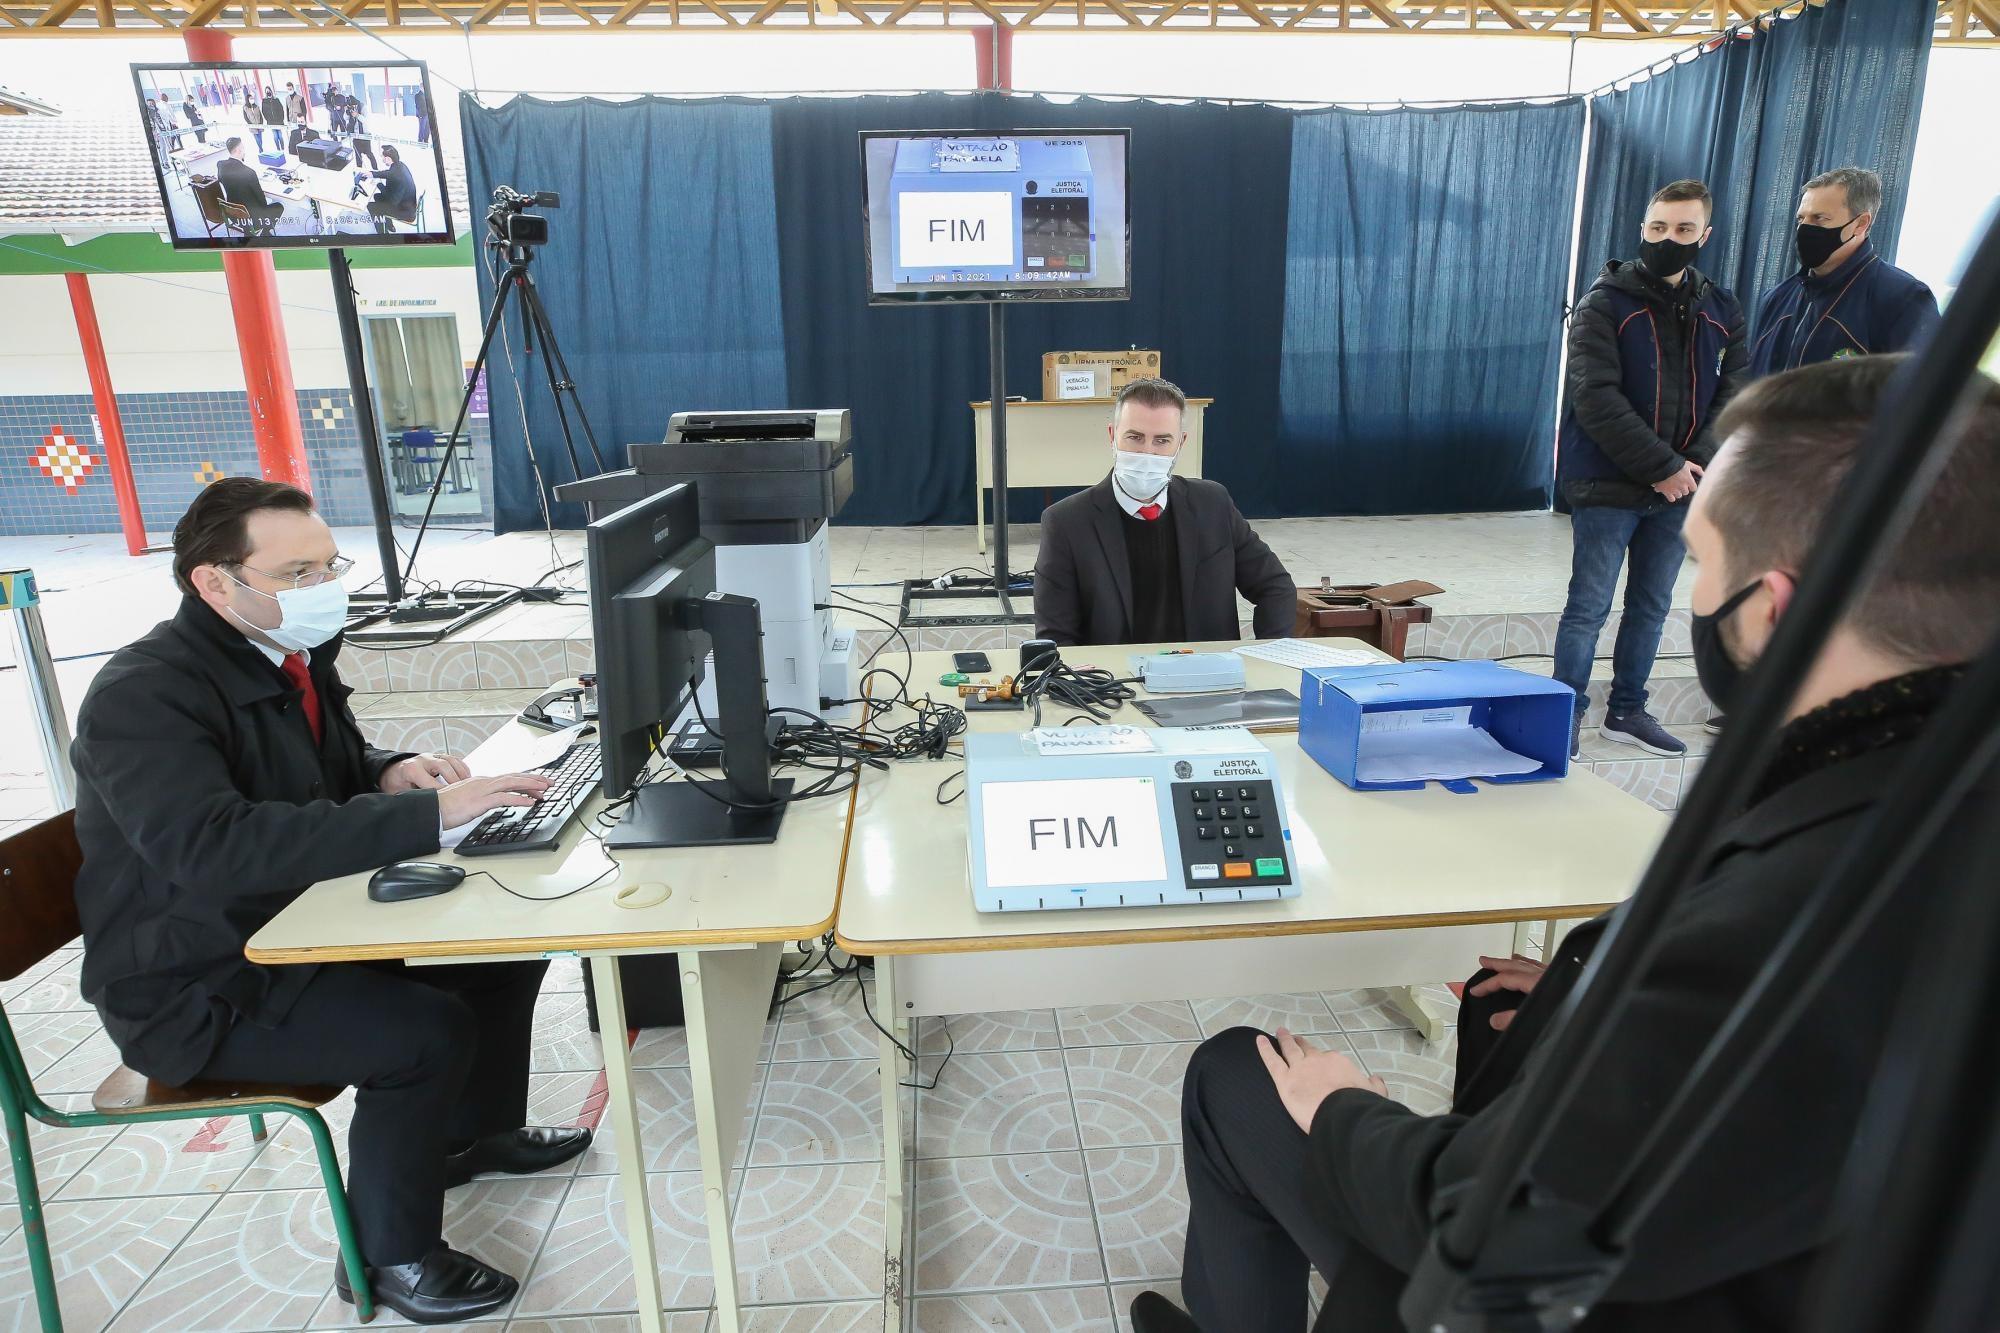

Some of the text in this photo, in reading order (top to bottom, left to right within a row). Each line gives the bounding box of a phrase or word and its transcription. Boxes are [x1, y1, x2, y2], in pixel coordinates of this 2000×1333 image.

[235, 217, 254, 226] JUN
[258, 217, 271, 226] 13
[929, 219, 985, 242] FIM
[928, 271, 1071, 281] JUN 13 2021 8:09:42AM
[1219, 759, 1257, 768] JUSTIÇA
[1213, 768, 1264, 776] ELEITORAL
[1217, 789, 1224, 797] 2
[1241, 788, 1247, 796] 3
[1196, 808, 1203, 816] 4
[1029, 816, 1118, 850] FIM
[1199, 825, 1254, 835] 7 8 9
[1227, 846, 1233, 854] 0
